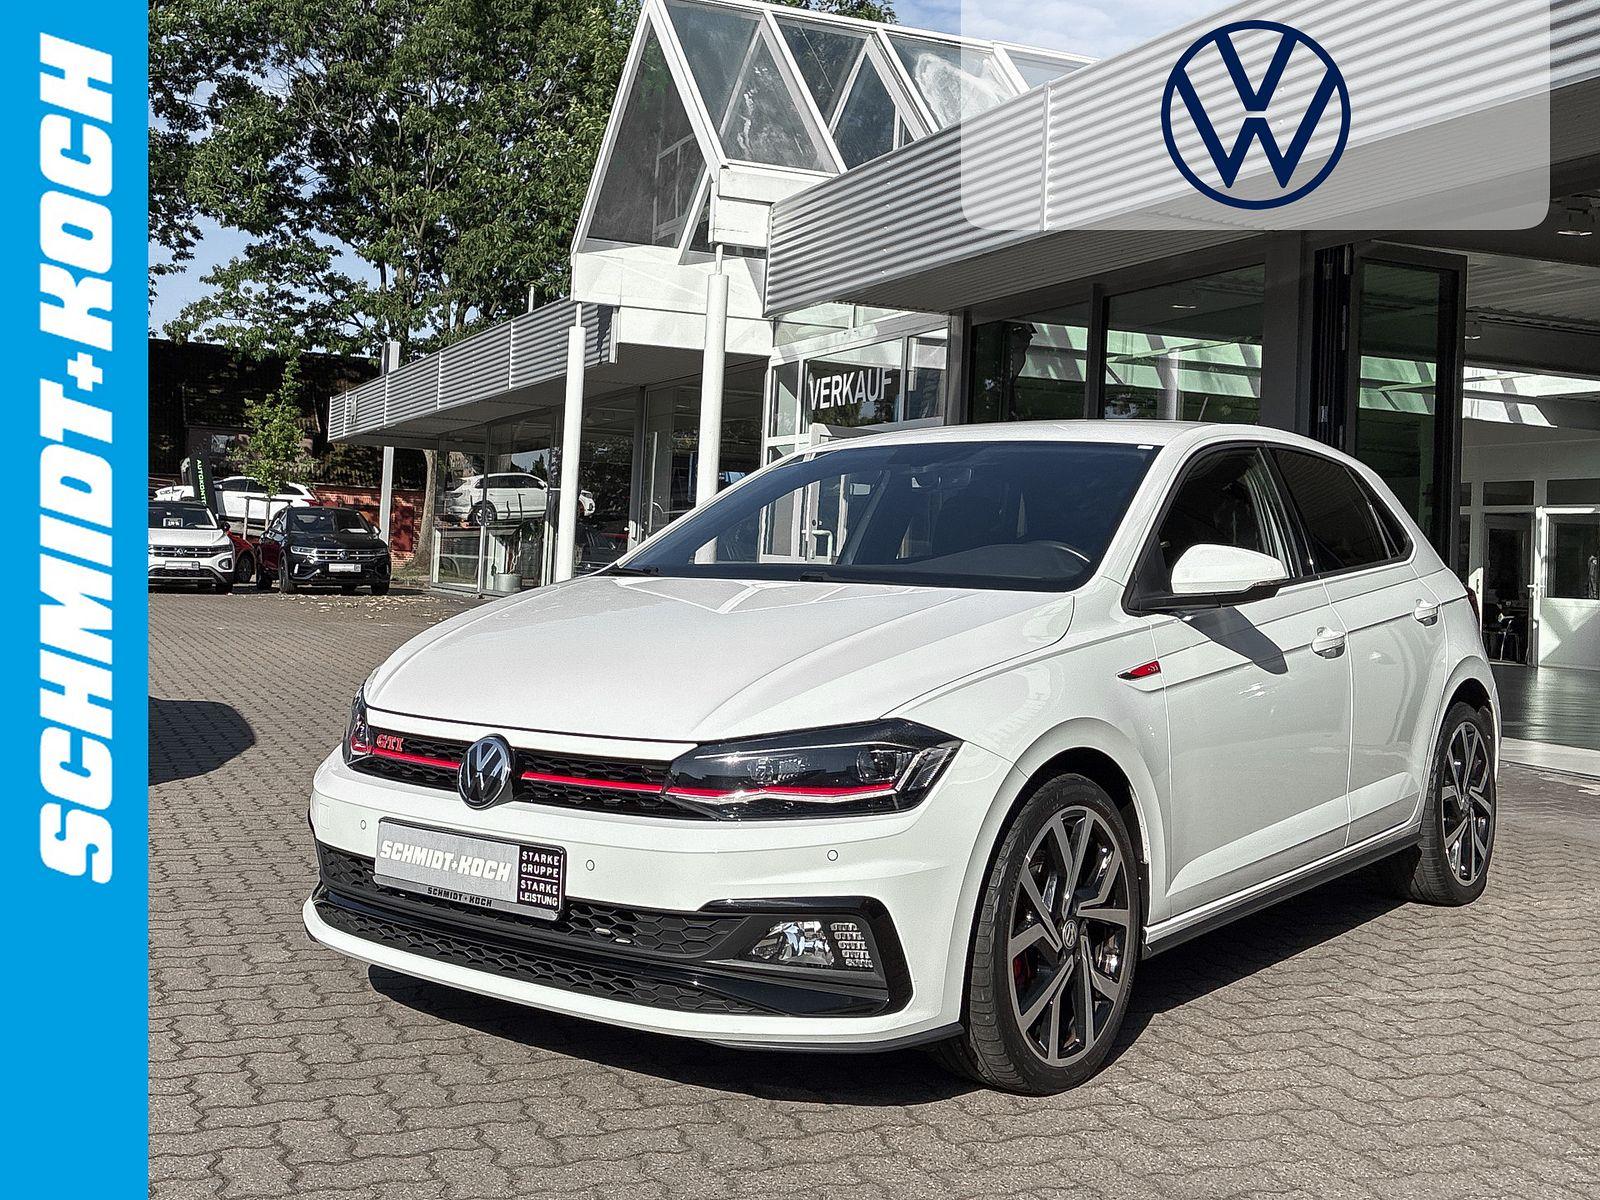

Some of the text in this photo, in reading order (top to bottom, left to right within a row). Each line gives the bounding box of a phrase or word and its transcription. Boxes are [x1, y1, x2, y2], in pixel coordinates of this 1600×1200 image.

[809, 368, 892, 411] VERKAUF
[376, 733, 404, 752] GTI
[380, 840, 513, 882] SCHMIDT+KOCH
[521, 850, 560, 866] STARKE
[521, 862, 559, 878] GRUPPE
[520, 879, 558, 895] STARKE
[427, 886, 463, 901] SCHMIDT
[469, 894, 492, 907] KOCH
[519, 891, 558, 906] LEISTUNG
